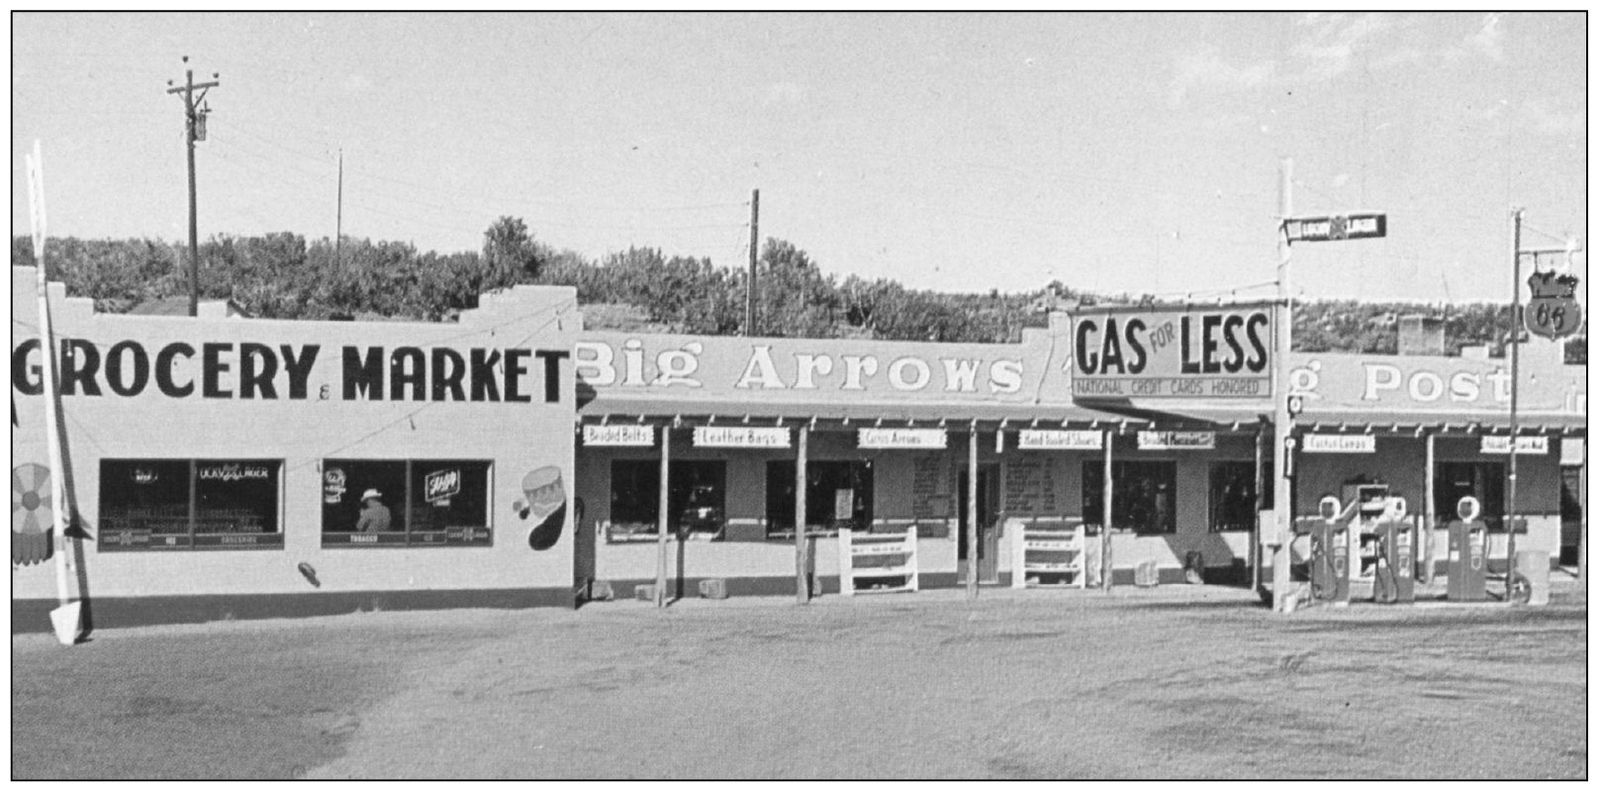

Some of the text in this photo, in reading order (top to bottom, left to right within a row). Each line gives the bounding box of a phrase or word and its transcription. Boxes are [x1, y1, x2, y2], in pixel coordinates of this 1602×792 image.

[1537, 303, 1566, 331] 66
[1076, 313, 1268, 375] GAS FOR LESS
[12, 338, 320, 400] GROCERY
[342, 346, 570, 402] MARKET
[576, 339, 704, 387] Big
[734, 344, 1024, 395] Arrows
[1361, 363, 1511, 403] Post
[1077, 380, 1260, 394] NATIONAL CREDIT CARDS HONORED
[702, 429, 777, 446] Leather Bags
[350, 534, 378, 543] TOBACCO
